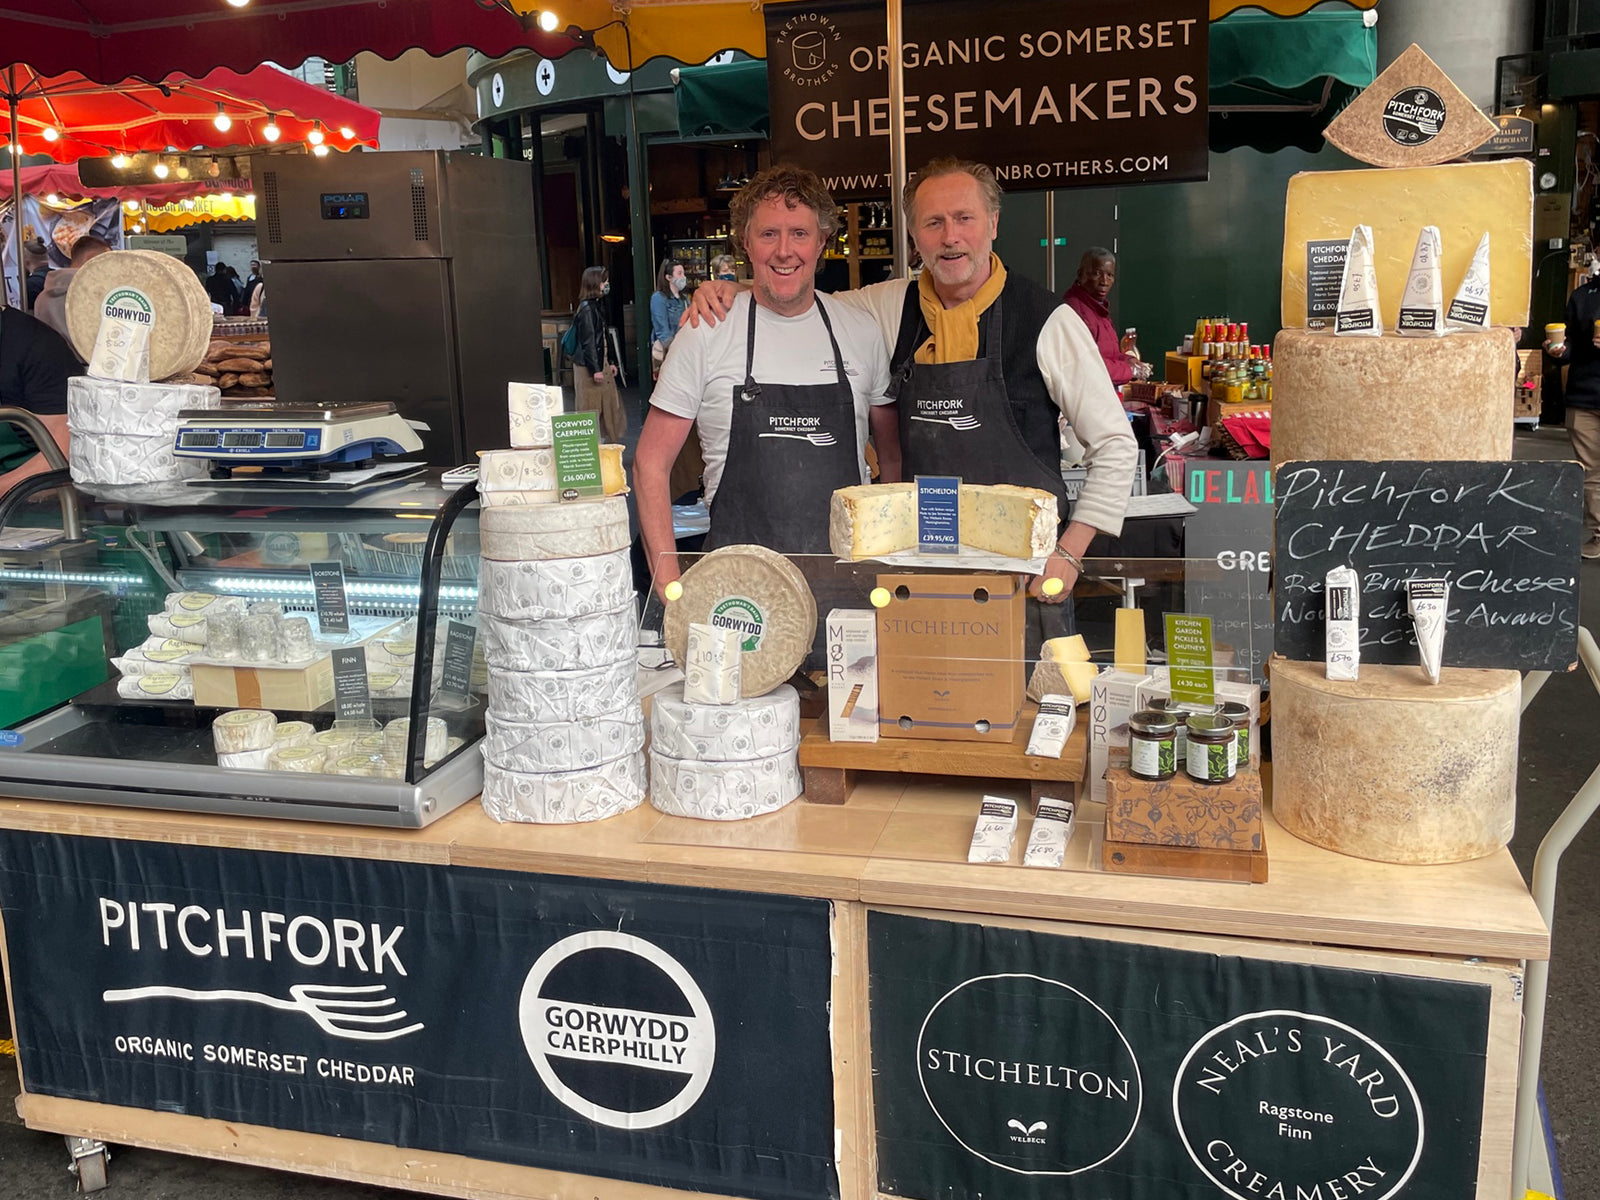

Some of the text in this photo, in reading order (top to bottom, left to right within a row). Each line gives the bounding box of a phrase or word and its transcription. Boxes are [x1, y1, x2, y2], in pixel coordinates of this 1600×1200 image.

[776, 13, 841, 44] TRETHOWAN
[849, 20, 1197, 72] ORGANIC SOMERSET
[783, 63, 839, 87] BROTHERS
[795, 74, 1198, 142] CHEESEMAKERS
[1387, 100, 1445, 122] PITCHFORK
[105, 306, 151, 324] GORWYDD
[1401, 320, 1433, 328] PITCHFORK
[1450, 311, 1482, 323] PITCHFORK
[1341, 321, 1372, 329] PITCHFORK
[917, 400, 964, 410] PITCHFORK
[554, 420, 593, 429] GORWYDD
[769, 417, 820, 427] PITCHFORK
[555, 428, 594, 438] CAERPHILLY
[920, 487, 957, 495] STICHELTON
[1288, 521, 1556, 560] CHEDDAR
[1411, 582, 1444, 590] PITCHFORK
[712, 615, 762, 636] GORWYDD
[1175, 620, 1202, 628] KITCHEN
[1466, 603, 1576, 632] Awards
[883, 619, 1000, 636] STICHELTON
[1176, 627, 1203, 635] GARDEN
[1173, 643, 1207, 652] CHUTNEYS
[1174, 635, 1204, 644] PICKLES &
[983, 804, 1013, 812] PITCHFORK
[1040, 806, 1070, 815] PITCHFORK
[99, 897, 408, 976] PITCHFORK
[545, 1006, 689, 1043] GORWYDD
[547, 1031, 687, 1064] CAERPHILLY
[115, 1036, 414, 1086] ORGANIC SOMERSET CHEDDAR
[928, 1048, 1130, 1101] STICHELTON
[1196, 1027, 1400, 1118] NEAL'S YARD
[1259, 1100, 1334, 1124] Ragstone
[1009, 1135, 1046, 1144] WELBECK
[1278, 1122, 1312, 1140] Finn
[1206, 1139, 1386, 1200] CREAMERY
